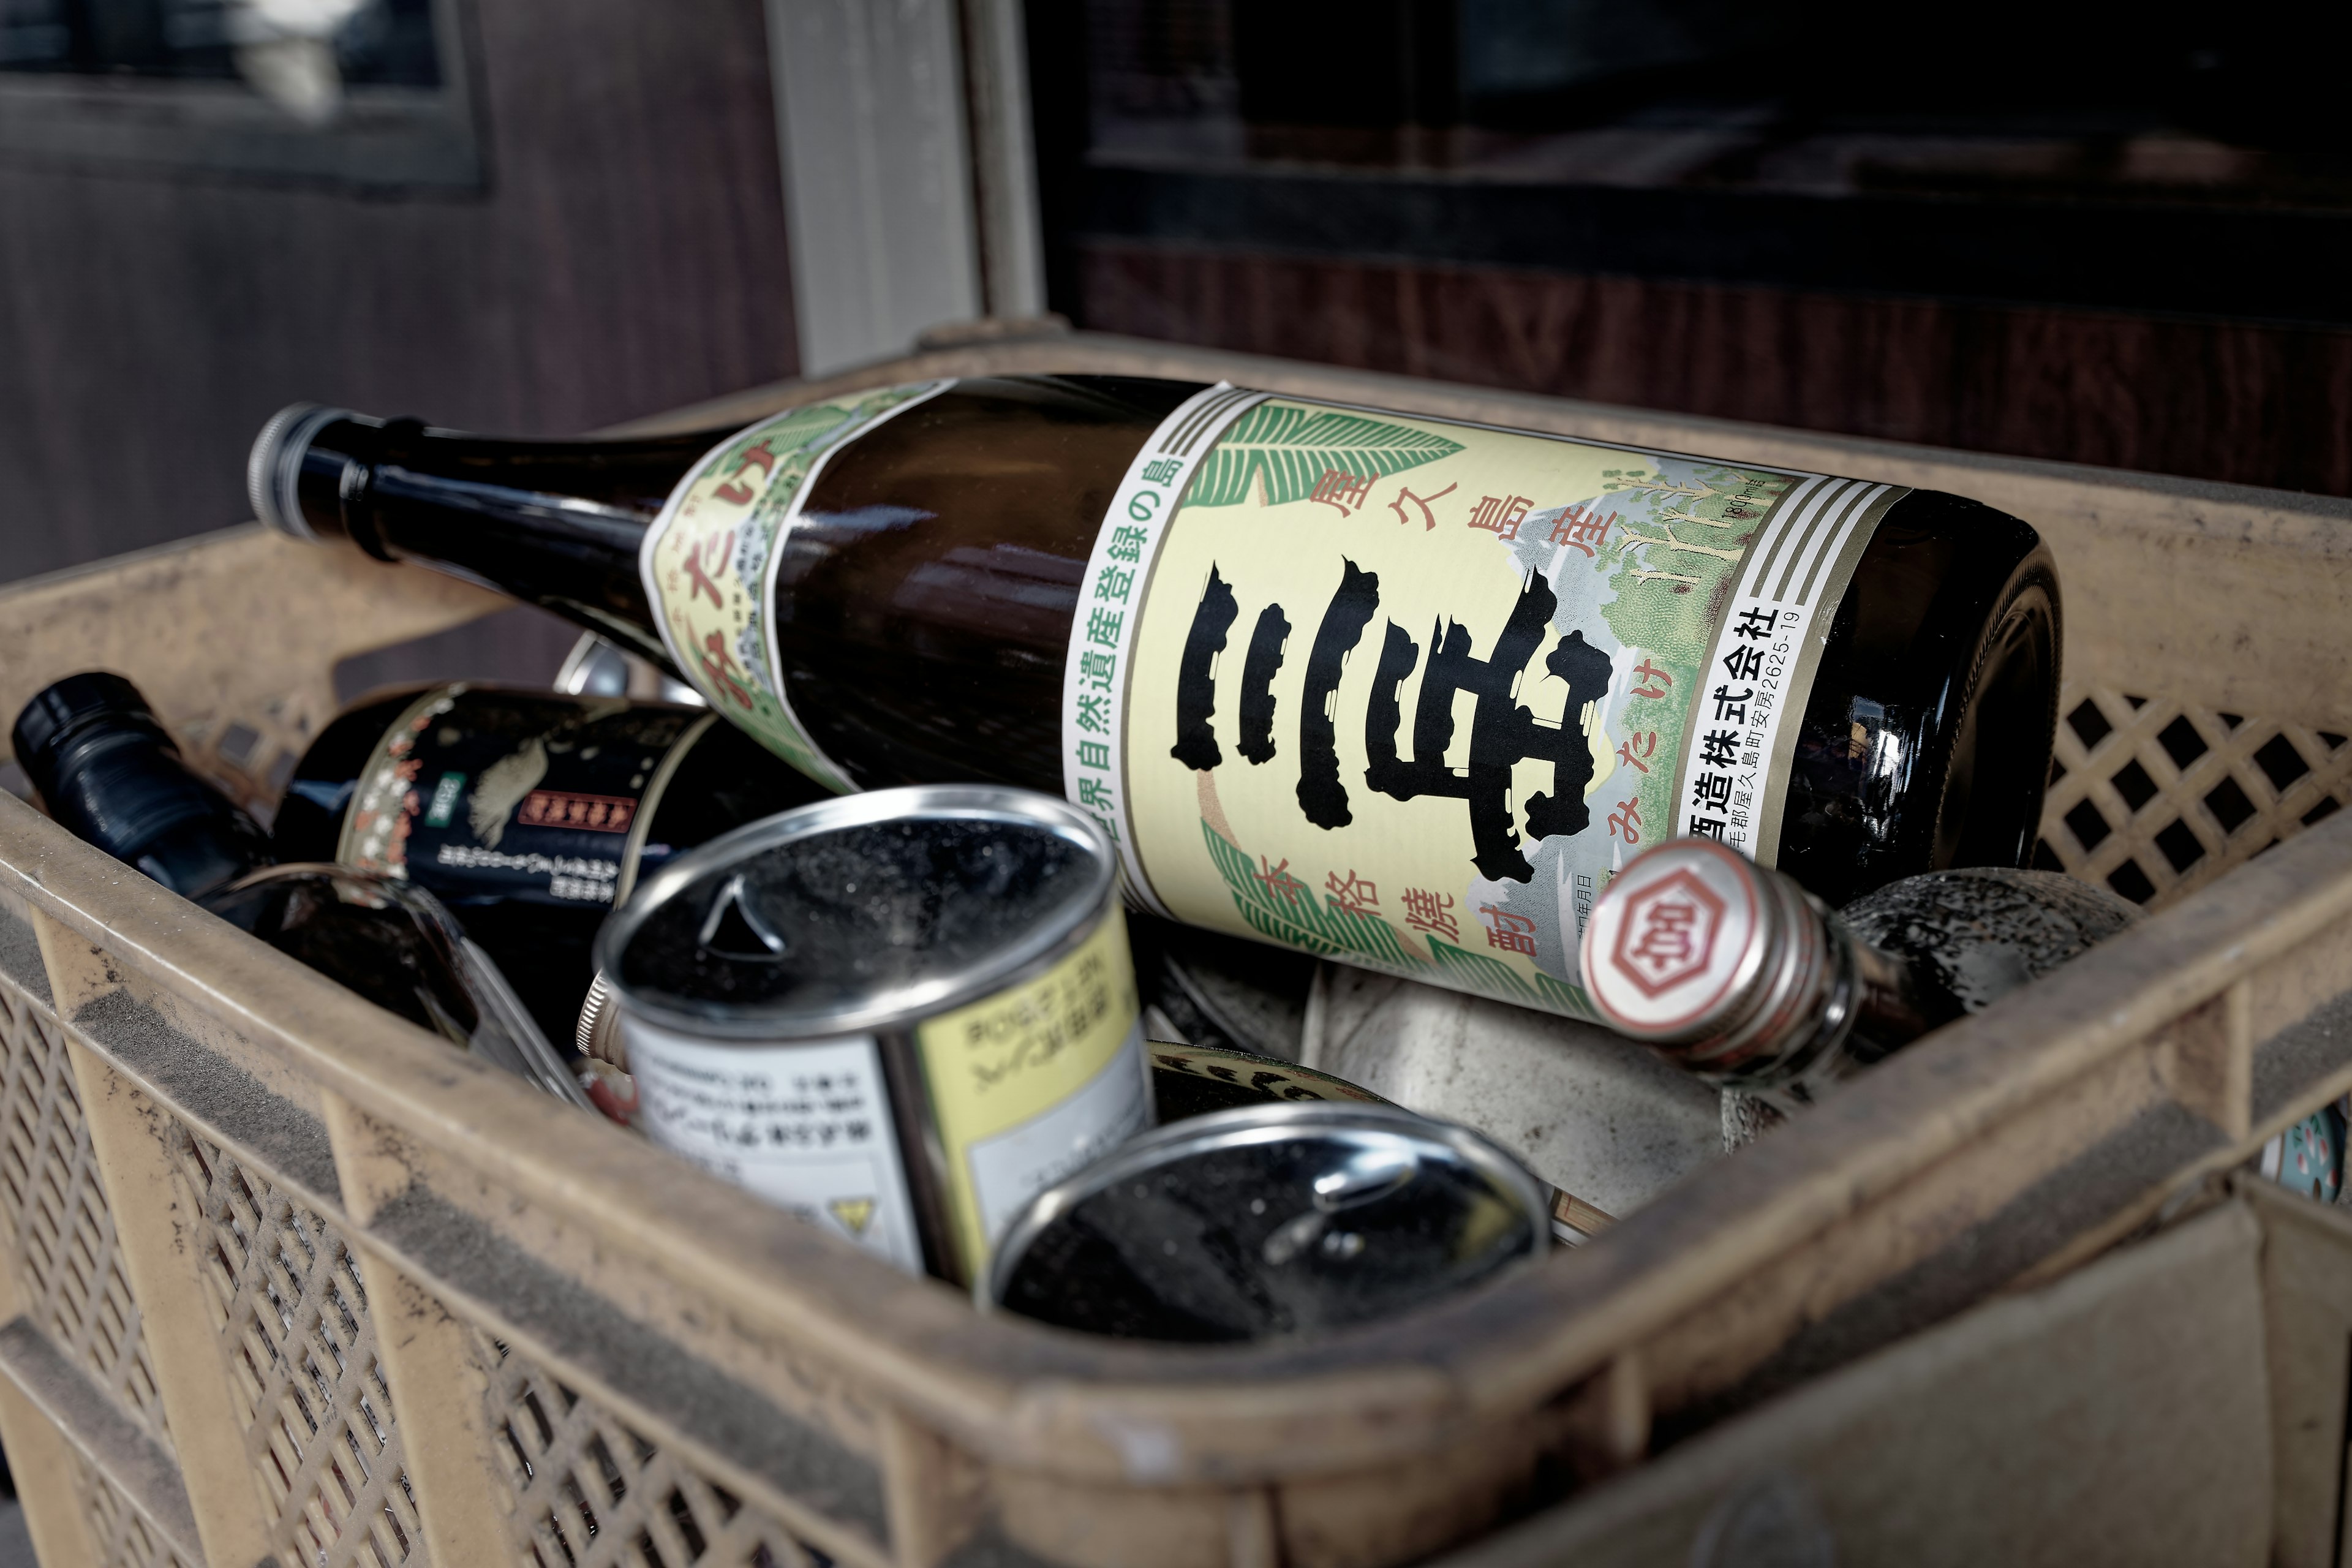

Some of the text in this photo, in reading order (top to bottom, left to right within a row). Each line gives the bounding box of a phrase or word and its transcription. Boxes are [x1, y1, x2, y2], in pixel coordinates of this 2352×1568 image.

[1310, 468, 1619, 558] 屋久島産
[1170, 554, 1613, 884] 三岳
[1608, 658, 1673, 845] みたけ
[1728, 611, 1800, 854] 毛郡屋久島町安房2625-19
